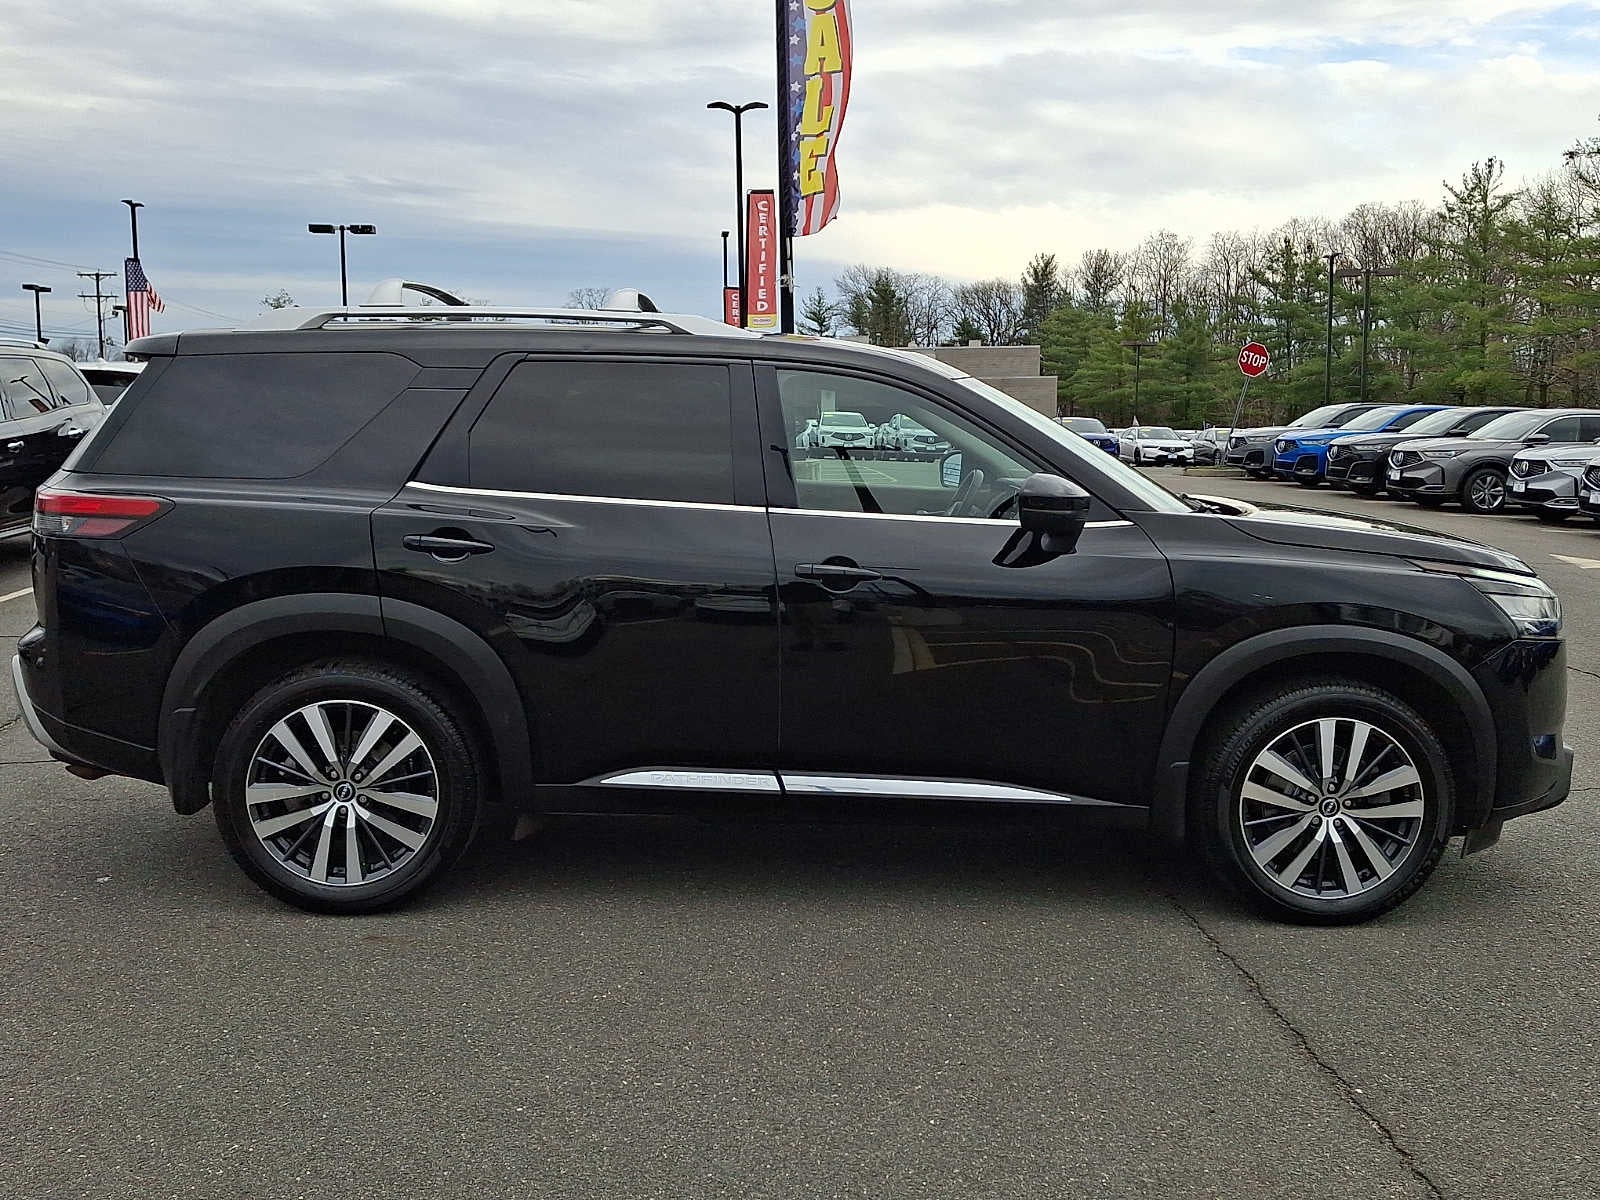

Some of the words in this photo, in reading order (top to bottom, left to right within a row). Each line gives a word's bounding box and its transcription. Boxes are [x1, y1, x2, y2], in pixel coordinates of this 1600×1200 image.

[800, 0, 842, 197] ALE
[757, 200, 769, 312] CERTIFIED
[1241, 351, 1266, 367] STOP
[651, 773, 771, 786] PATHFINDER
